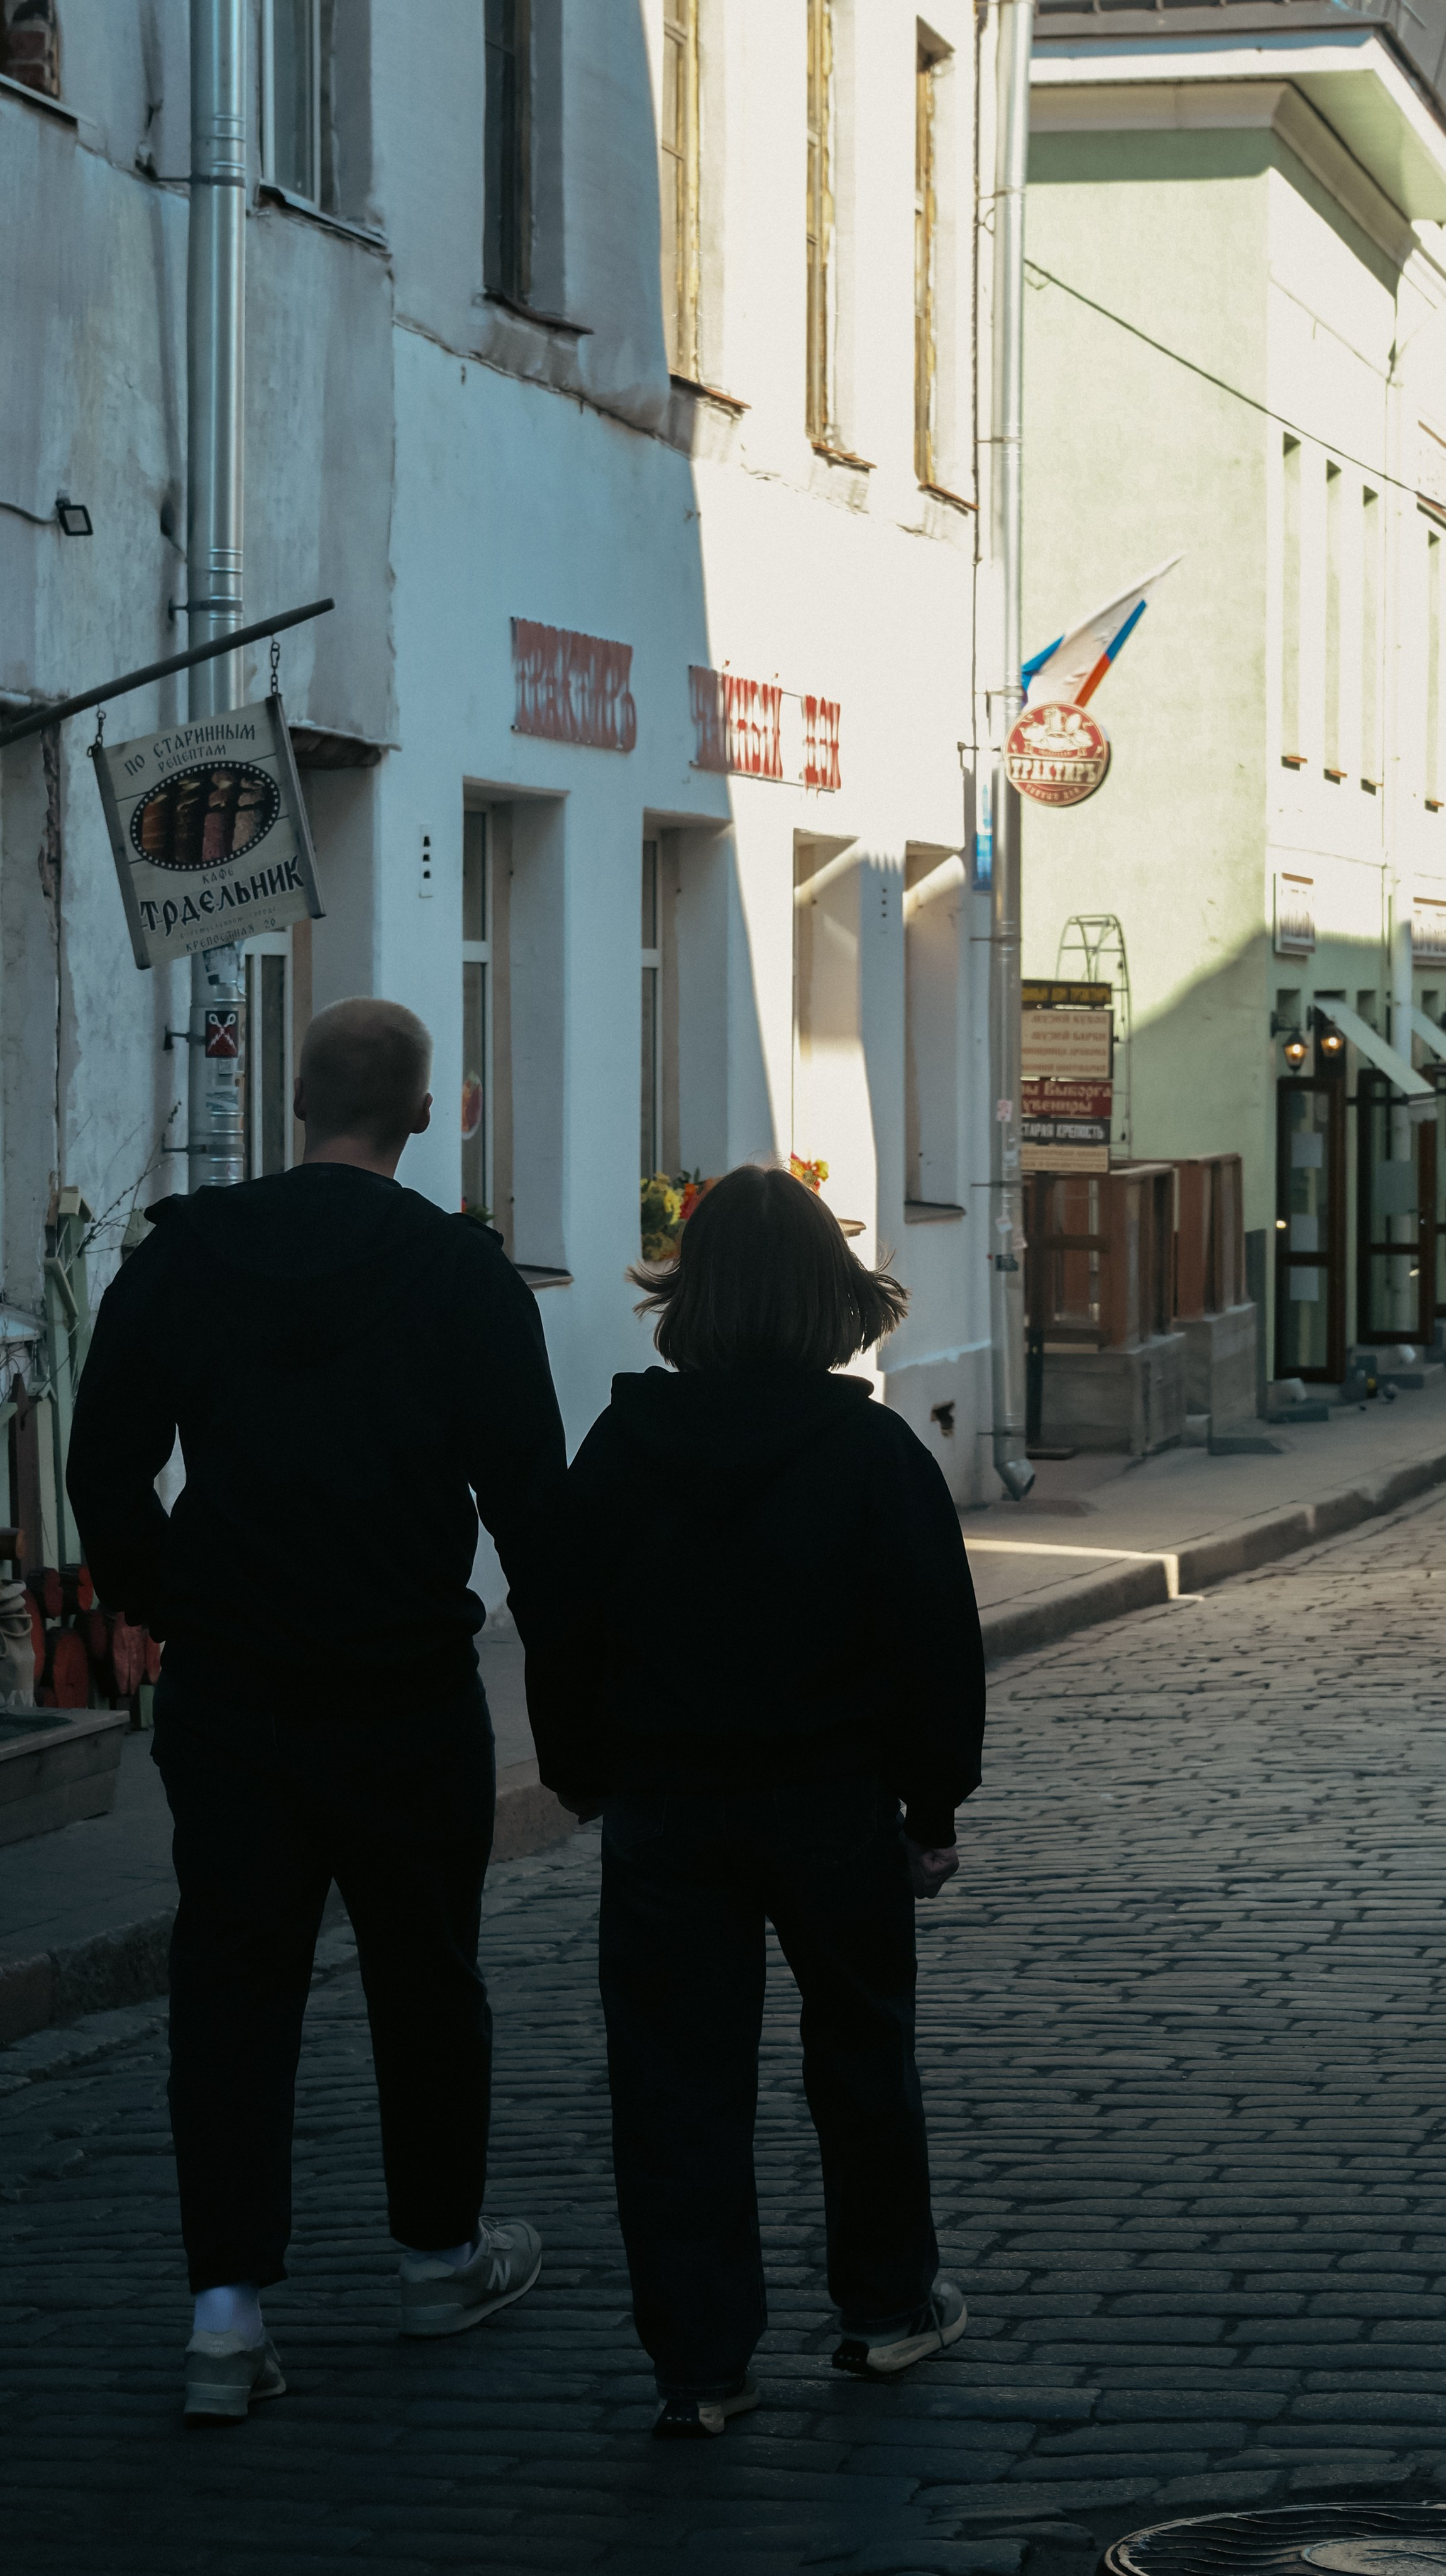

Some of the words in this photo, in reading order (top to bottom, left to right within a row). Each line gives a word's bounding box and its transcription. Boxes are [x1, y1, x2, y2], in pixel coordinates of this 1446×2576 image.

[124, 755, 145, 776] ПО
[153, 724, 255, 758] СТАРИННЫМ
[158, 745, 226, 773] РЕЦЕПТАМ
[140, 855, 304, 937] ТРДЕЛЬНИК
[186, 924, 255, 952] КРЕПОСТНАЯ
[263, 918, 276, 930] 20
[1022, 1100, 1094, 1116] увениры
[487, 2258, 511, 2291] N
